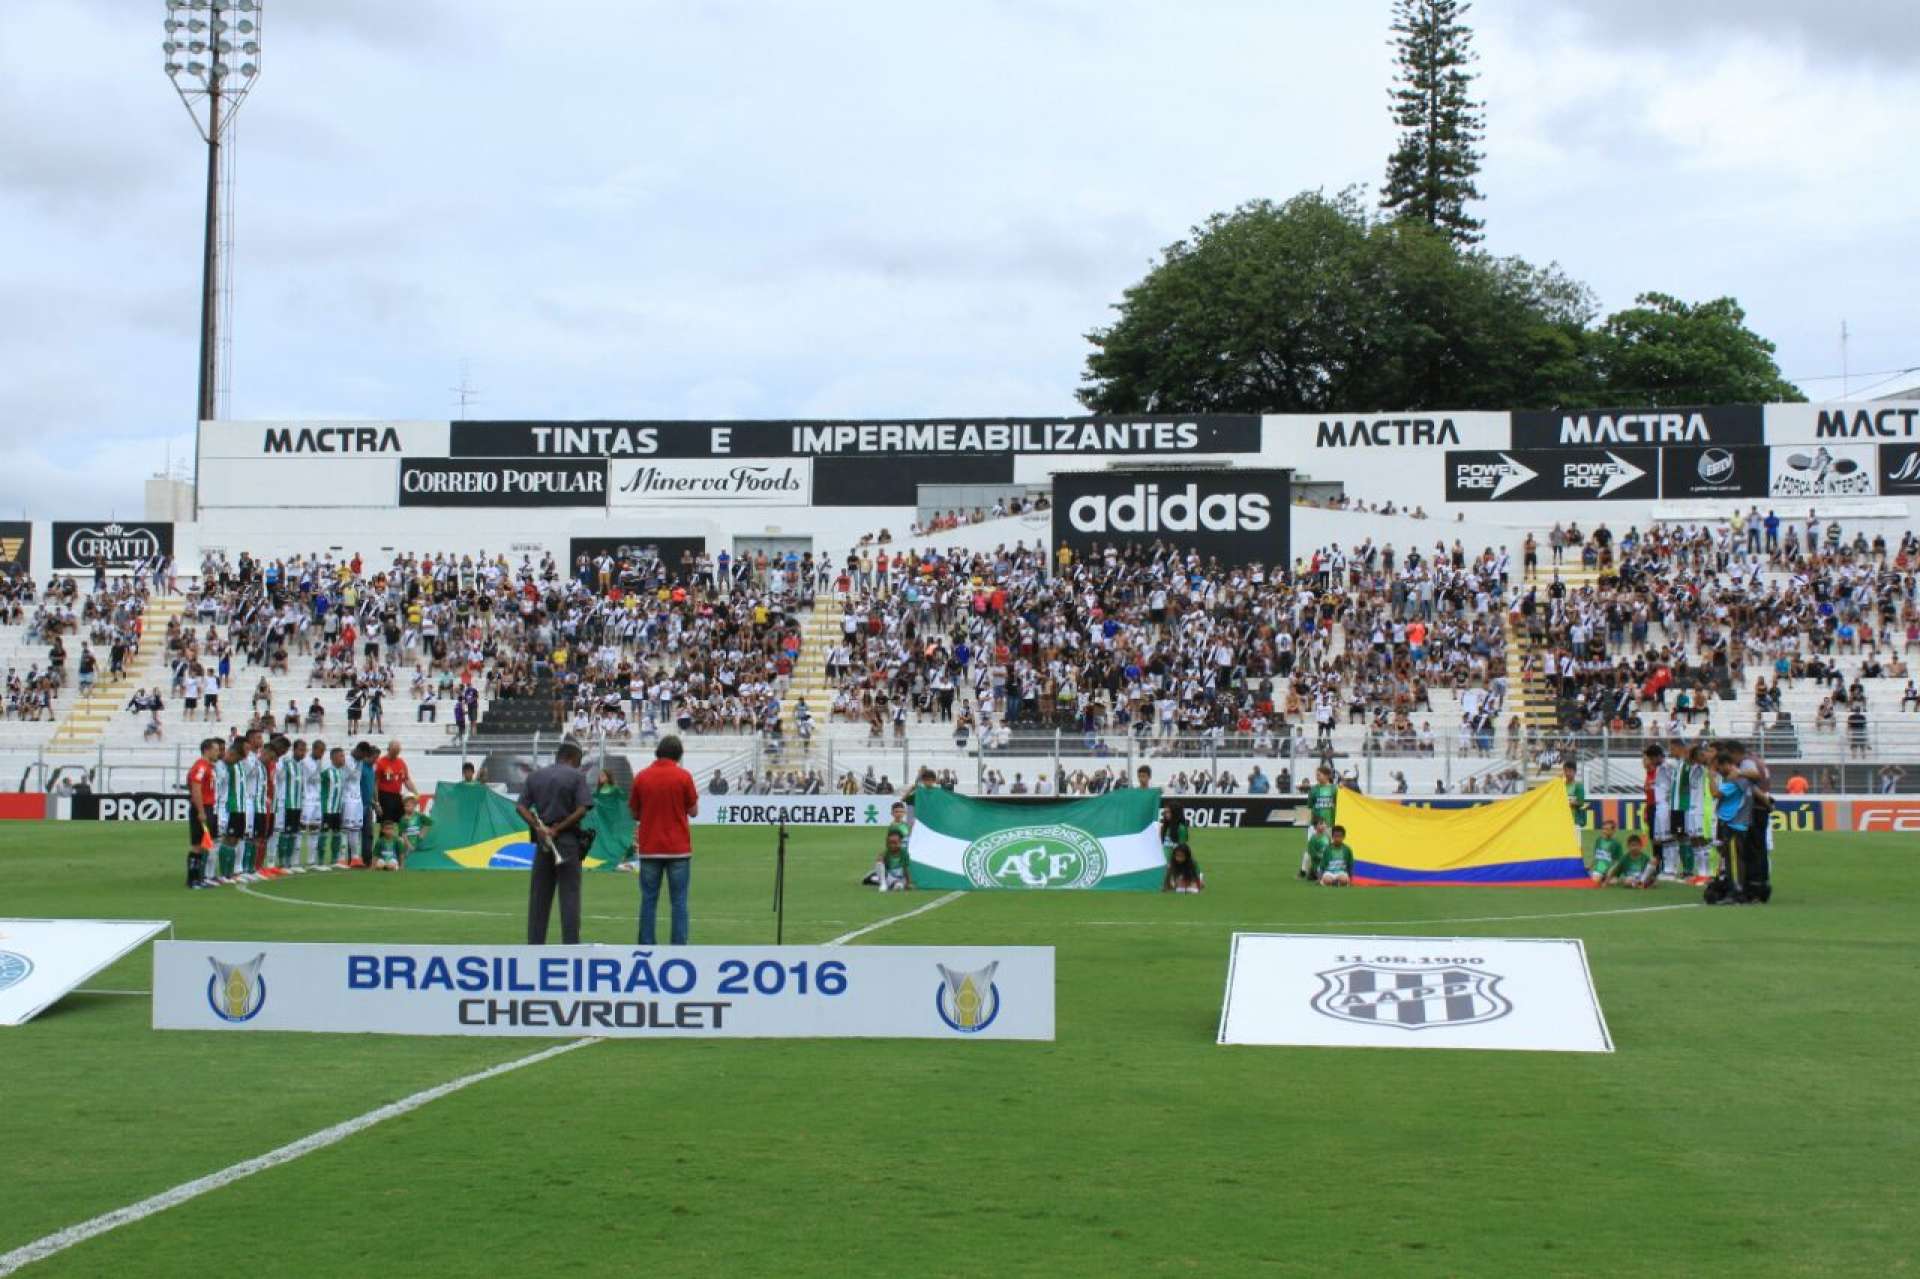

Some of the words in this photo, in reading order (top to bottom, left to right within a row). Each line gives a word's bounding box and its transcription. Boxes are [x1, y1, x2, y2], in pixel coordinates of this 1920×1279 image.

[263, 427, 402, 453] MACTRA
[531, 427, 658, 453] TINTAS
[710, 427, 732, 453] E
[792, 421, 1199, 453] IMPERMEABILIZANTES
[1316, 417, 1460, 448] MACTRA
[1559, 413, 1711, 445] MACTRA
[403, 468, 497, 494] CORREIO
[502, 468, 604, 494] POPULAR
[620, 466, 729, 493] Minerva
[729, 465, 801, 492] Foods
[1069, 483, 1270, 532] adidas
[77, 538, 149, 560] CERATTI
[99, 798, 190, 820] PROIB
[717, 805, 856, 826] #FORÇACHAPE
[347, 950, 697, 995] BRASILEIRÃO
[717, 959, 848, 995] 2016
[458, 998, 732, 1029] CHEVROLET
